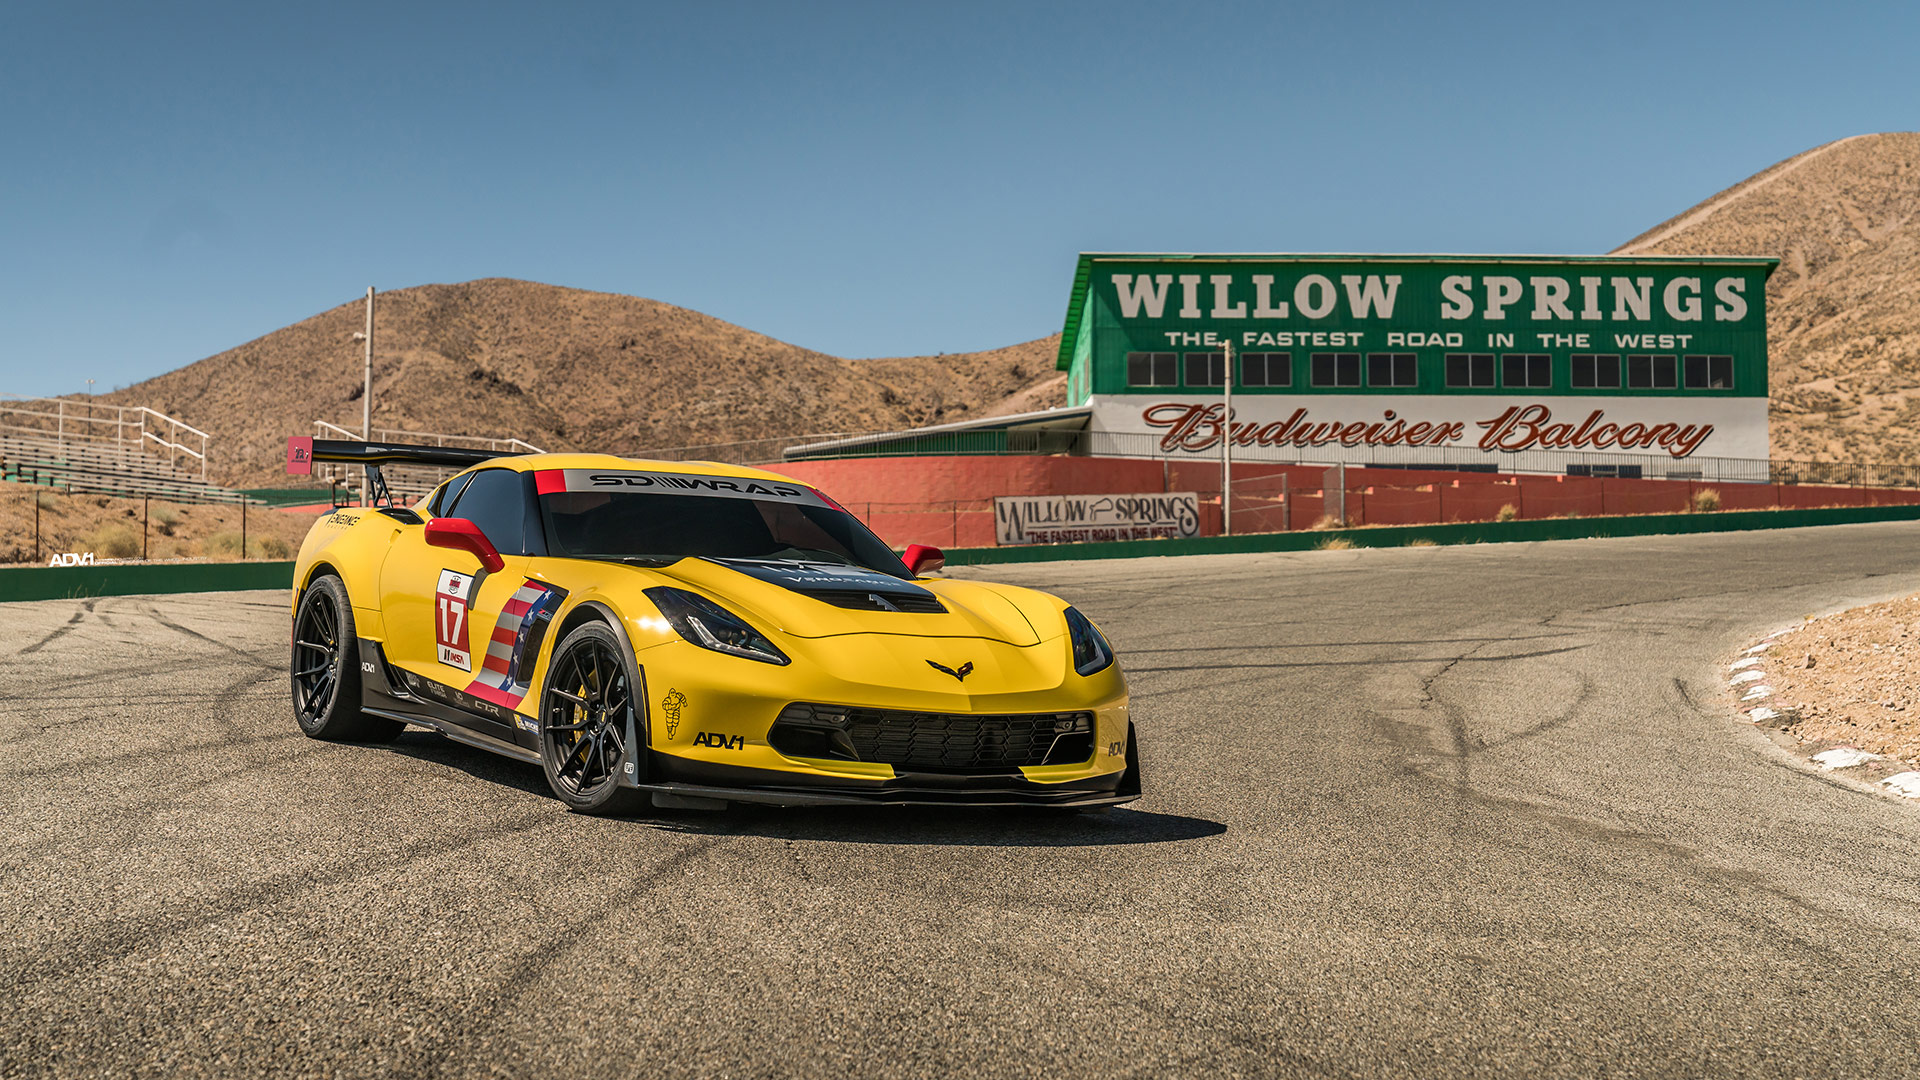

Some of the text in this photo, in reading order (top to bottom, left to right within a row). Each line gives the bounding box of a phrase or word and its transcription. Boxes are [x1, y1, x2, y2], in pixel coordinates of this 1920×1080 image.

[1111, 274, 1748, 321] WILLOW SPRINGS
[1164, 332, 1693, 348] THE FASTEST ROAD IN THE WEST
[1142, 403, 1714, 459] Budweiser Balcony
[998, 497, 1199, 541] WILLOW SPRINGS
[1050, 530, 1089, 543] FASTEST
[1092, 529, 1117, 541] ROAD
[1118, 529, 1128, 540] IN
[1129, 528, 1150, 540] THE
[440, 597, 464, 646] 17
